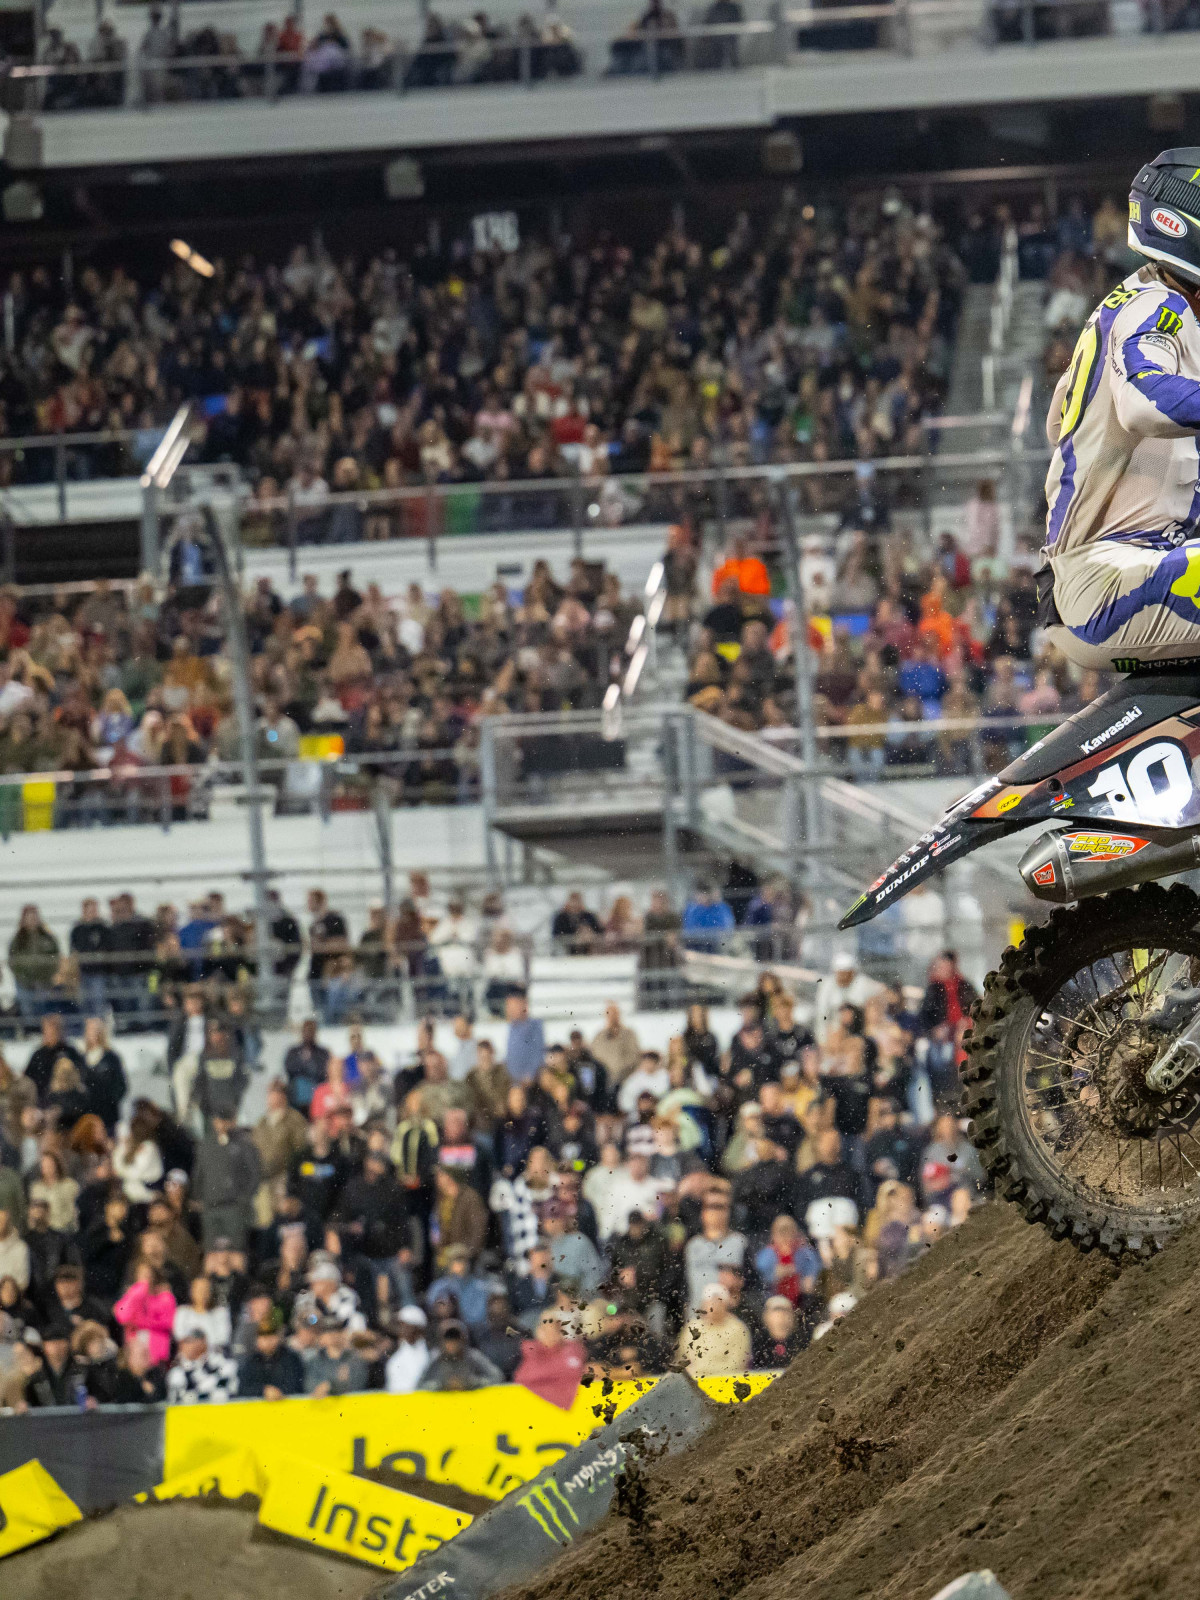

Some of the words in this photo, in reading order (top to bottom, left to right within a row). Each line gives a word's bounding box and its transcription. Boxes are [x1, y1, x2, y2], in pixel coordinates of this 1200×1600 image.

[1156, 212, 1180, 233] BELL
[1080, 705, 1143, 755] Kawasaki
[1087, 741, 1194, 828] 10
[1070, 843, 1133, 854] CIRCUIT
[1076, 836, 1111, 844] PRO
[875, 854, 930, 904] DUNLOP
